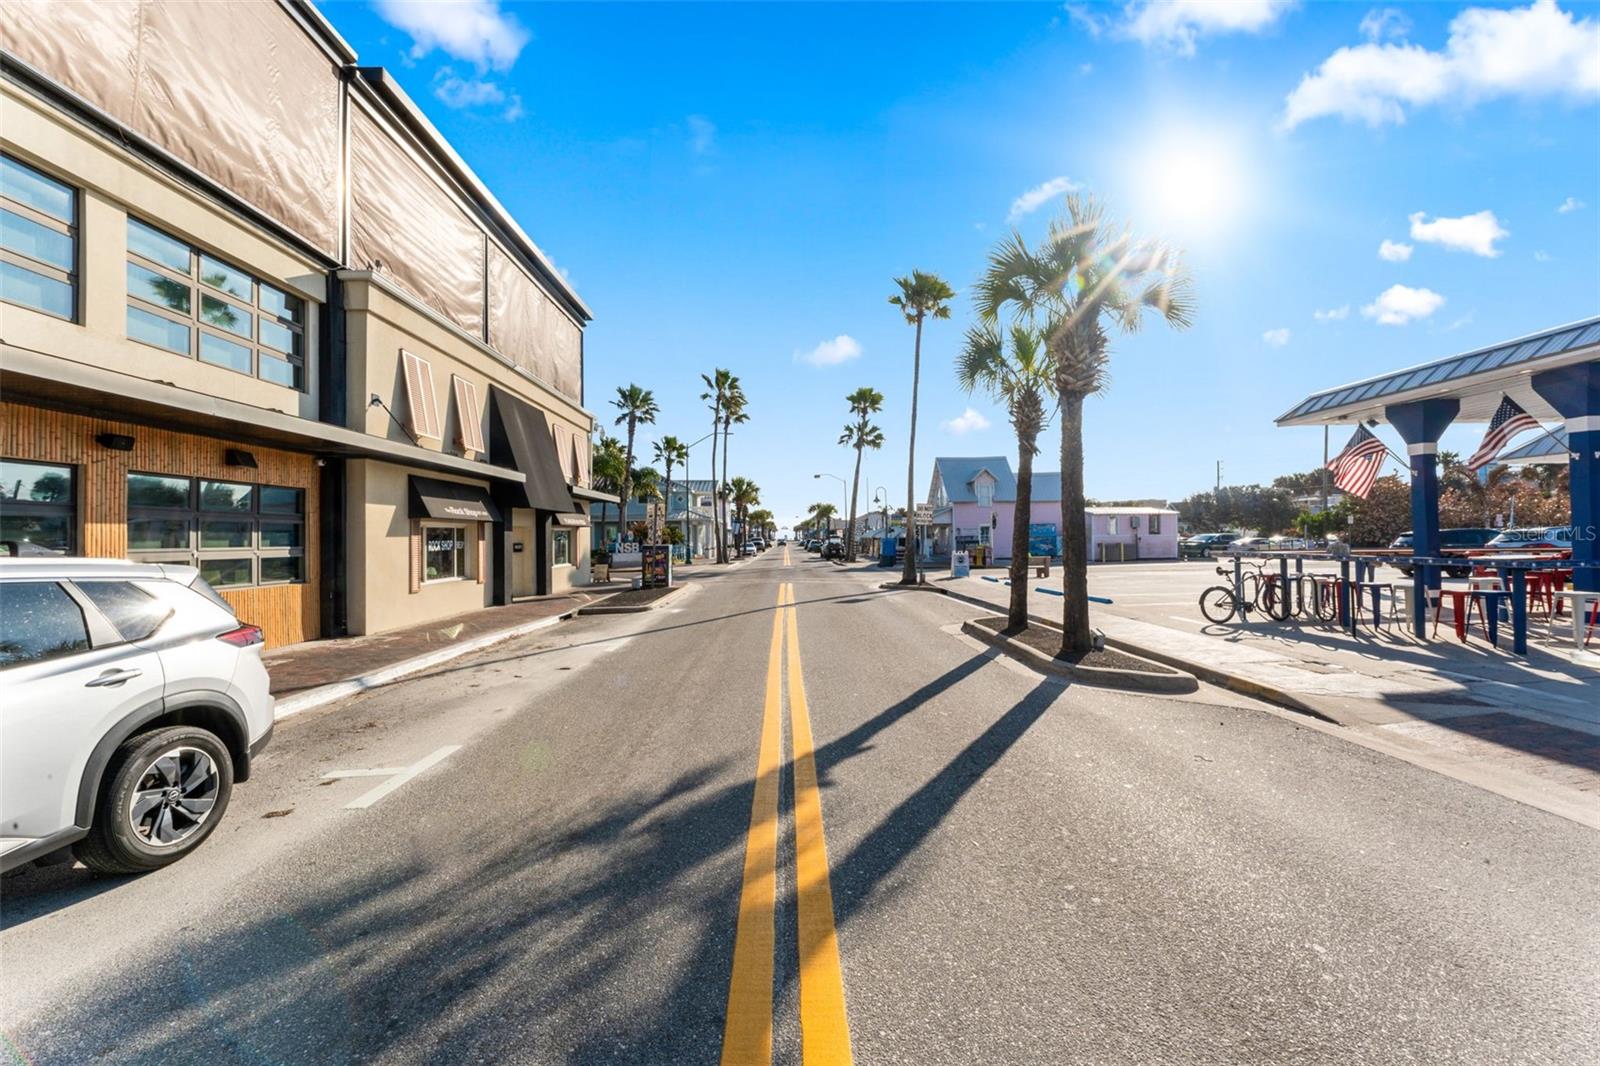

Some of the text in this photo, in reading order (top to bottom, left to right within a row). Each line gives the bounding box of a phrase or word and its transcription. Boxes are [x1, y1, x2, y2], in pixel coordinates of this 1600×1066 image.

[428, 540, 441, 552] ROCK
[441, 540, 454, 551] SHOP
[615, 542, 639, 553] NSB
